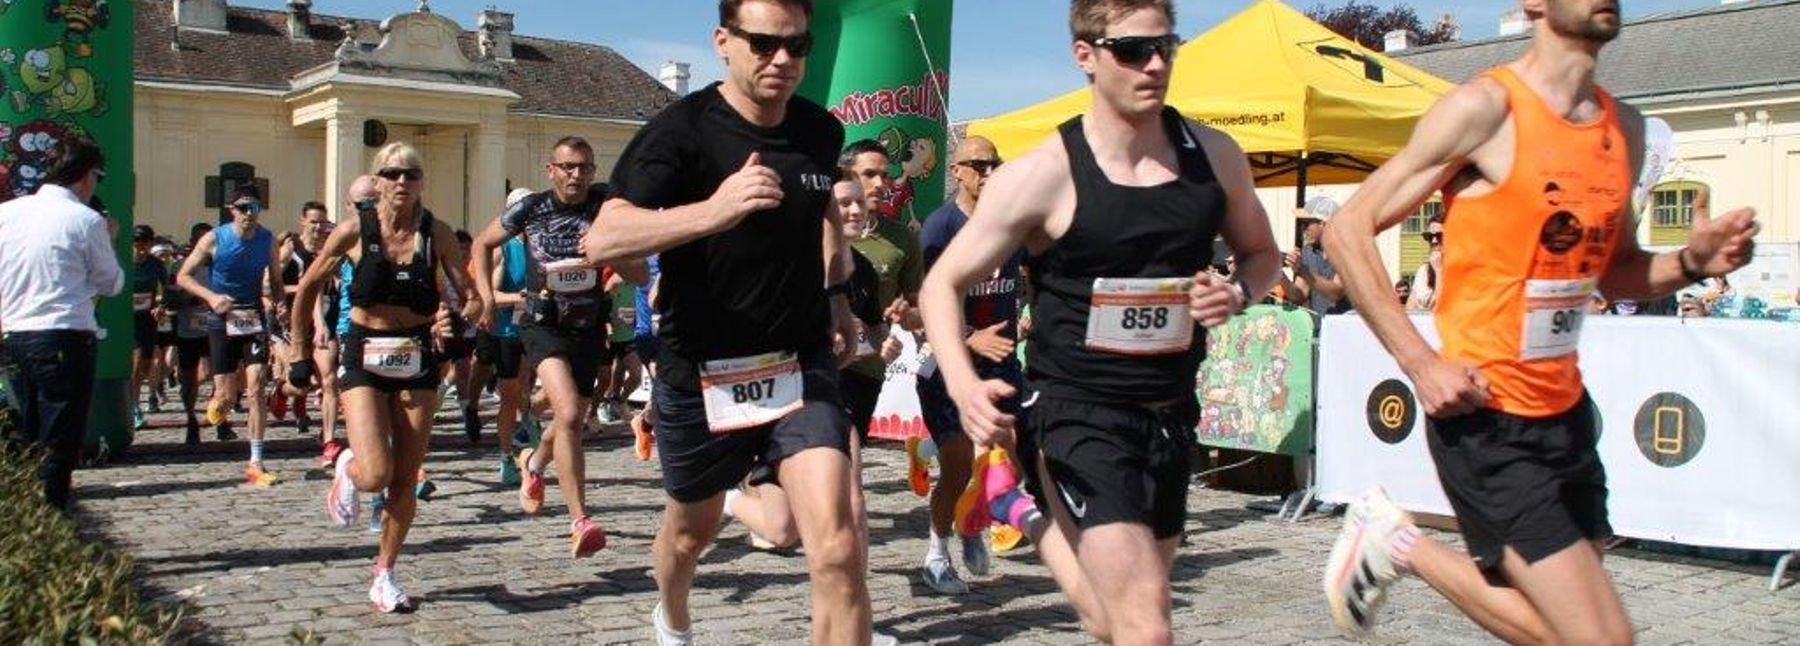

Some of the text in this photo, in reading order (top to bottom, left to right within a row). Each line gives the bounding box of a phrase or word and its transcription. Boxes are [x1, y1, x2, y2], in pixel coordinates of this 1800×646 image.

[558, 270, 588, 282] 1020
[1121, 306, 1169, 330] 858
[378, 352, 411, 367] 1092
[731, 377, 776, 404] 807
